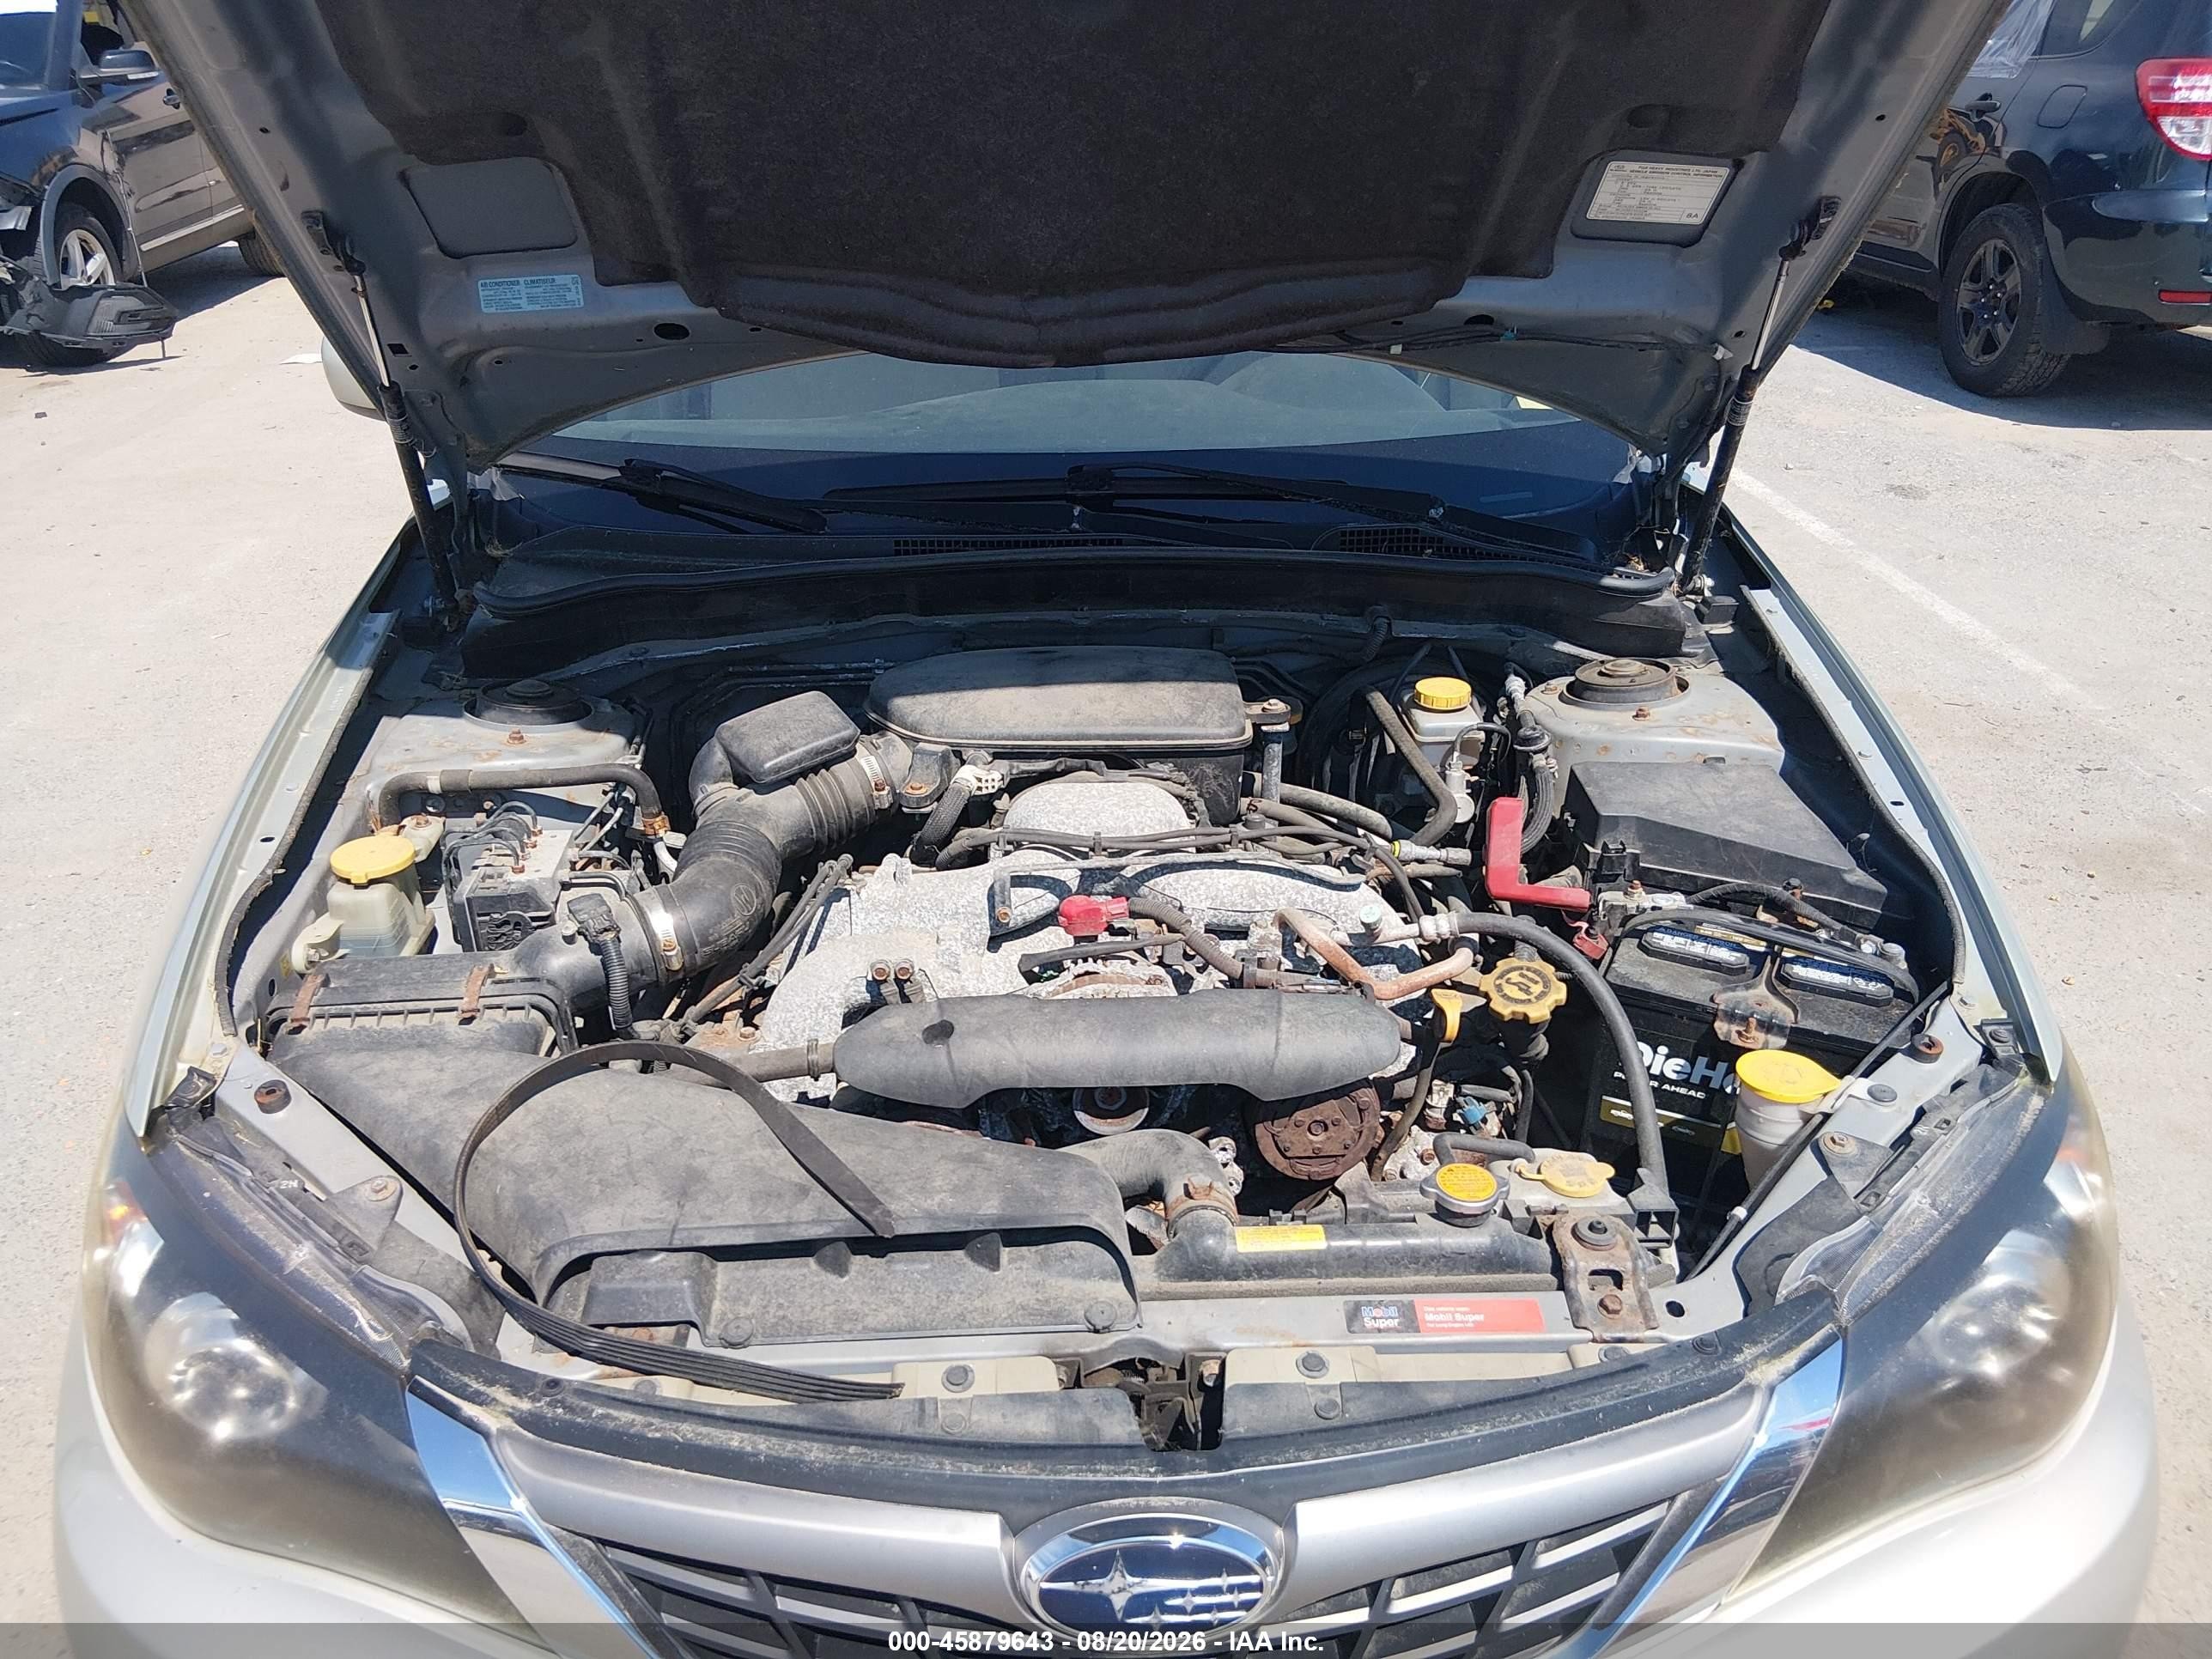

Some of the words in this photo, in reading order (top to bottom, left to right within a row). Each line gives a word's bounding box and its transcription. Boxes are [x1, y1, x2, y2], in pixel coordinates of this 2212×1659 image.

[1662, 1084, 1706, 1099] AHEAD
[1361, 1304, 1399, 1317] Mobil
[1364, 1317, 1400, 1328] Super
[1424, 1312, 1453, 1322] Mobil
[1455, 1313, 1485, 1323] Super
